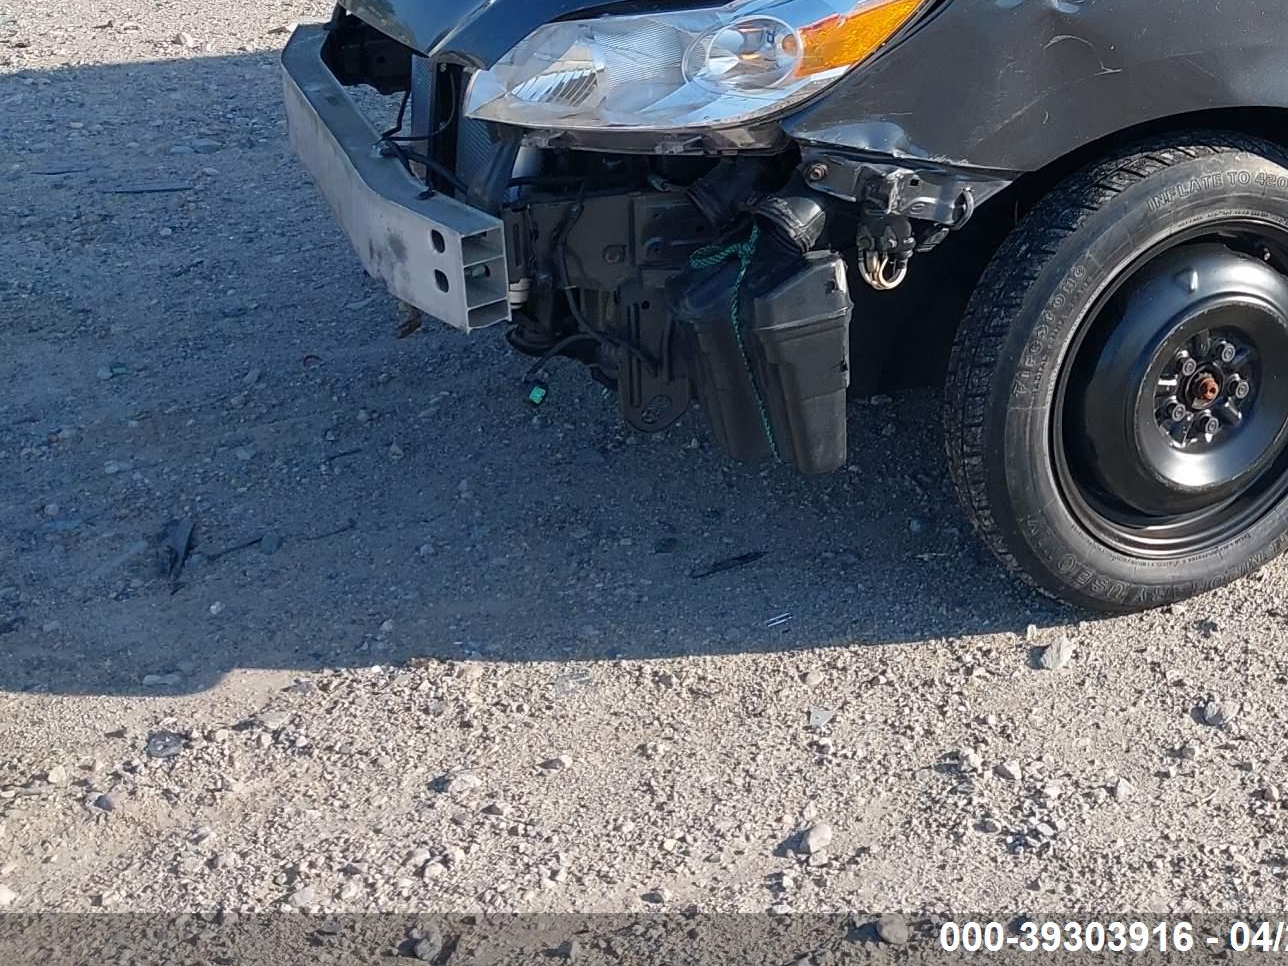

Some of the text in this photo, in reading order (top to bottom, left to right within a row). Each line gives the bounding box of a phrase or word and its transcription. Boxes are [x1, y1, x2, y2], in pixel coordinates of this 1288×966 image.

[1145, 171, 1224, 212] INFLATE
[1227, 170, 1251, 185] TO
[1254, 170, 1288, 189] 420
